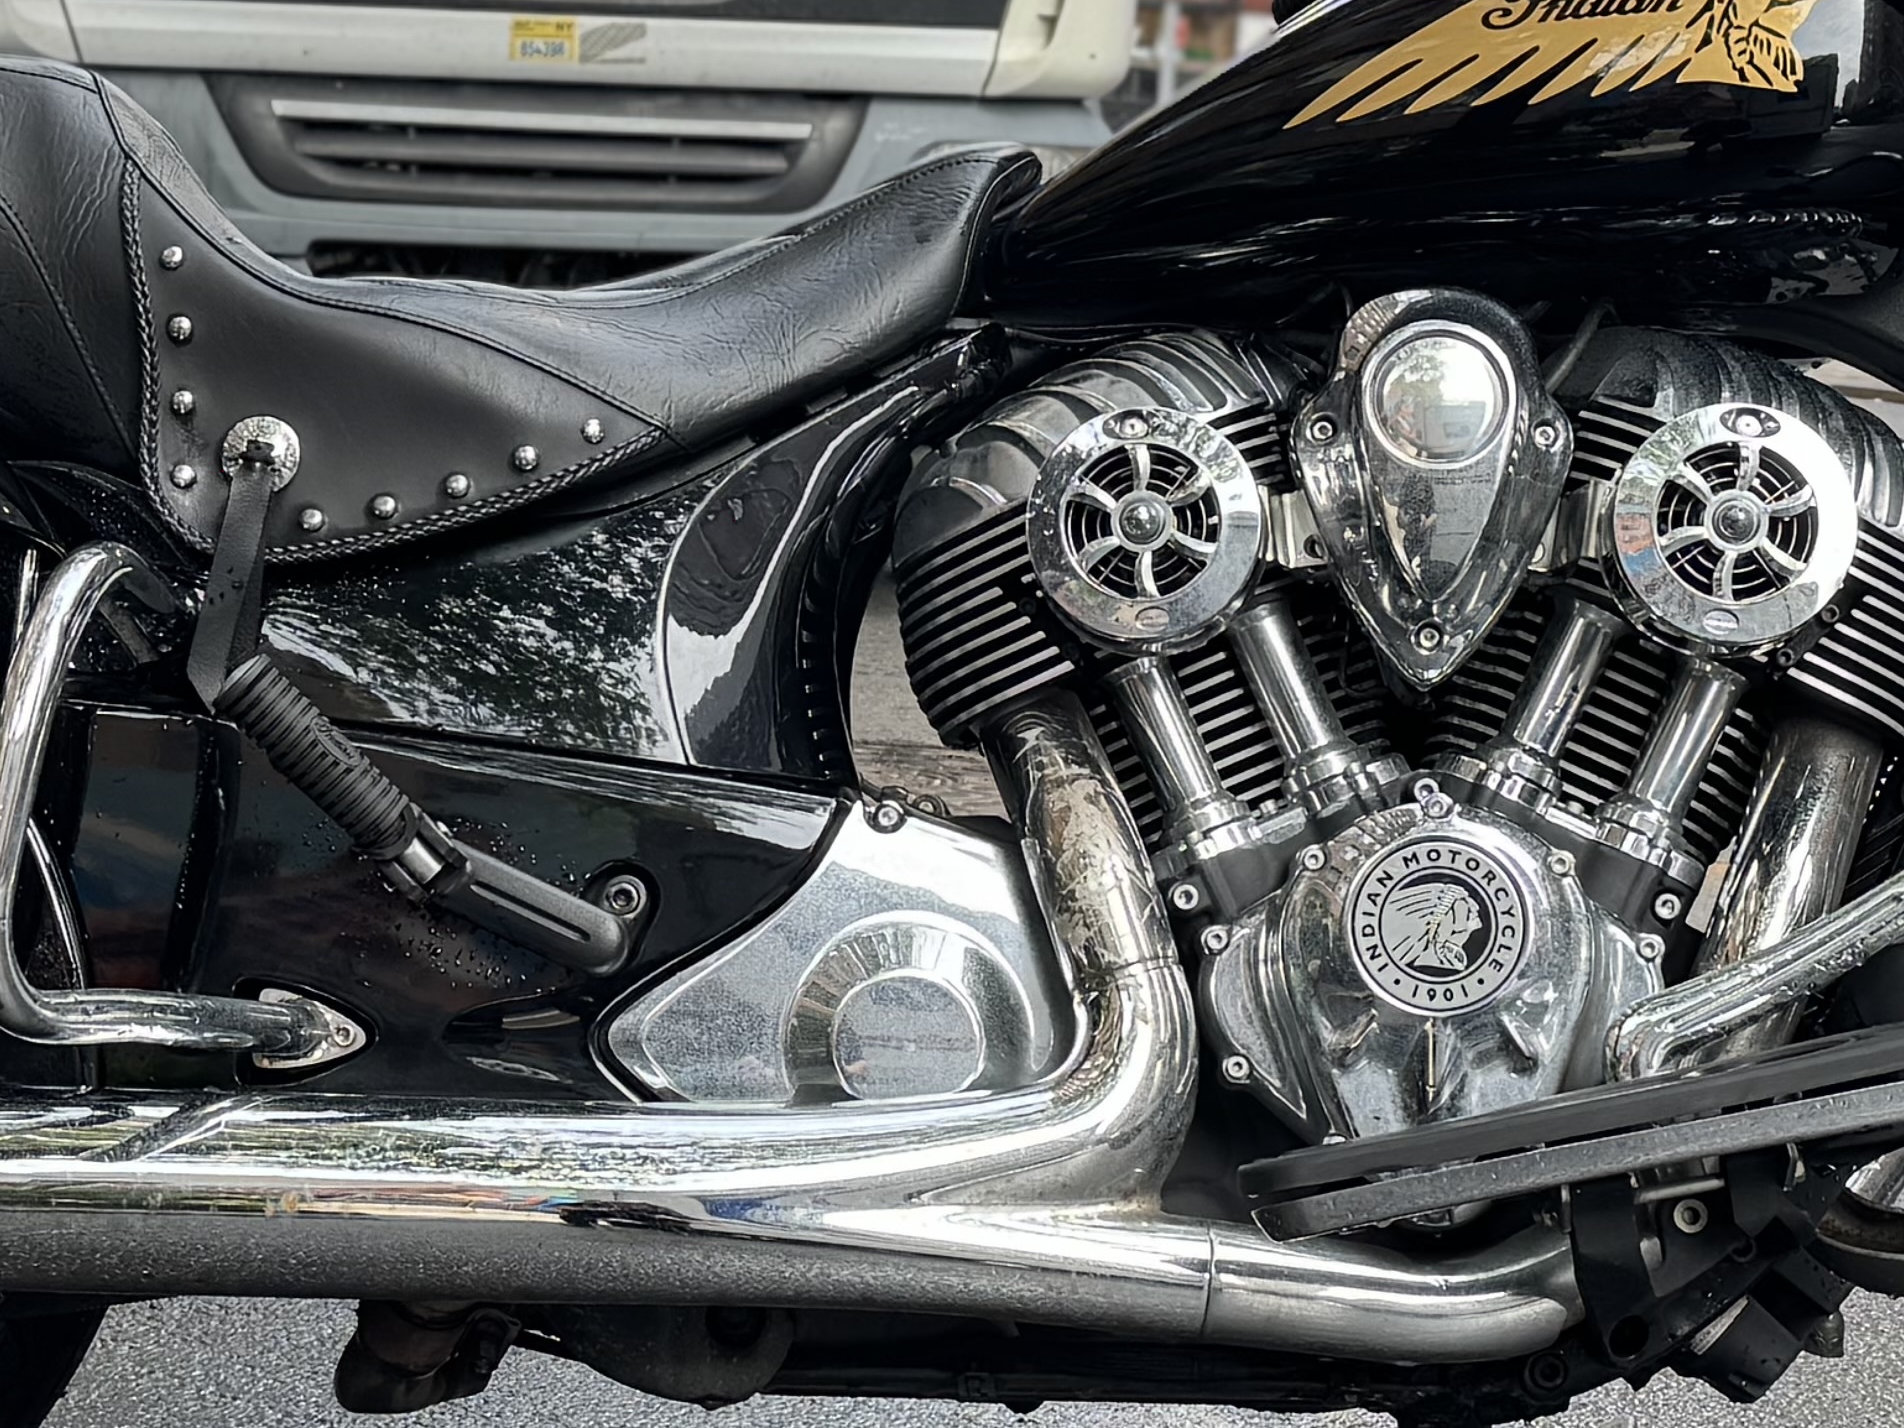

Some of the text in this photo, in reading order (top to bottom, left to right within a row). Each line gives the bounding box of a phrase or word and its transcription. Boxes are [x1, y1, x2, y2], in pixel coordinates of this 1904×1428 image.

[1361, 848, 1516, 973] INDIAN MOTORCYCLE
[1411, 983, 1469, 1002] 1901
